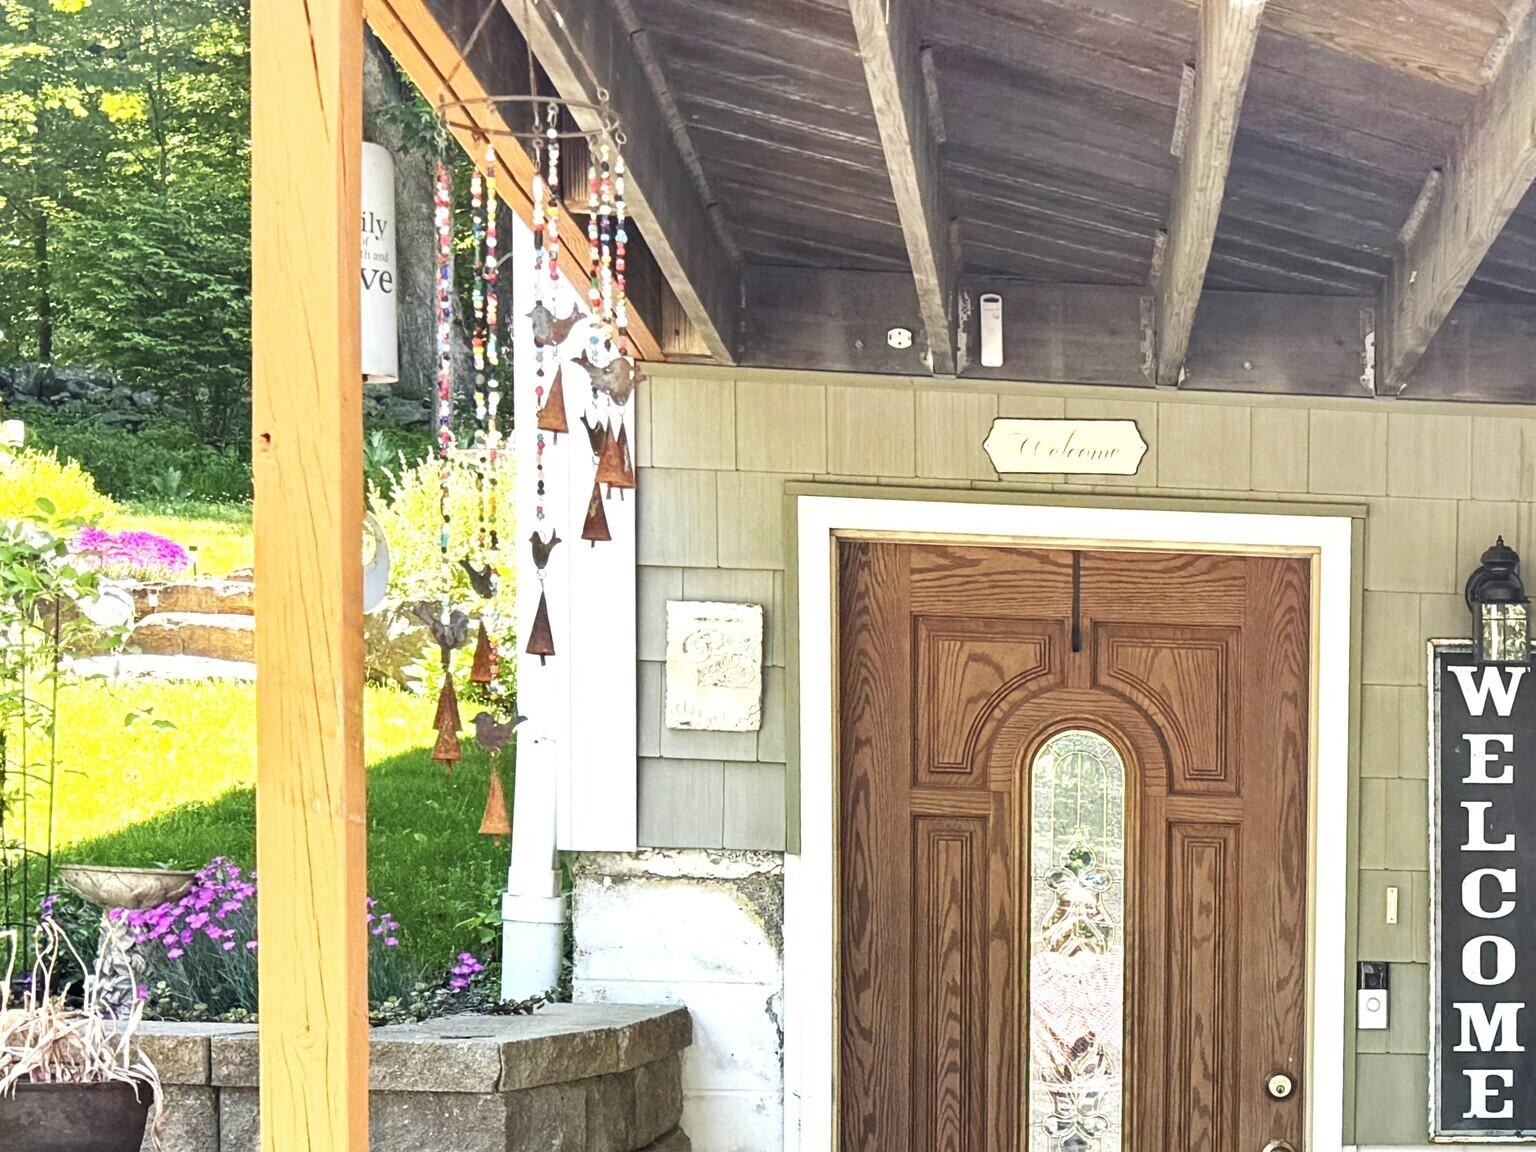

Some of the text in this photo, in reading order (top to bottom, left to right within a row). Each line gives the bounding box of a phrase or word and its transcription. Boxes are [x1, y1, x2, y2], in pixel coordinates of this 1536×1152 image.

[361, 211, 387, 240] ily
[361, 268, 393, 294] ve
[1008, 429, 1120, 461] Welcome
[1447, 666, 1530, 1119] WELCOME
